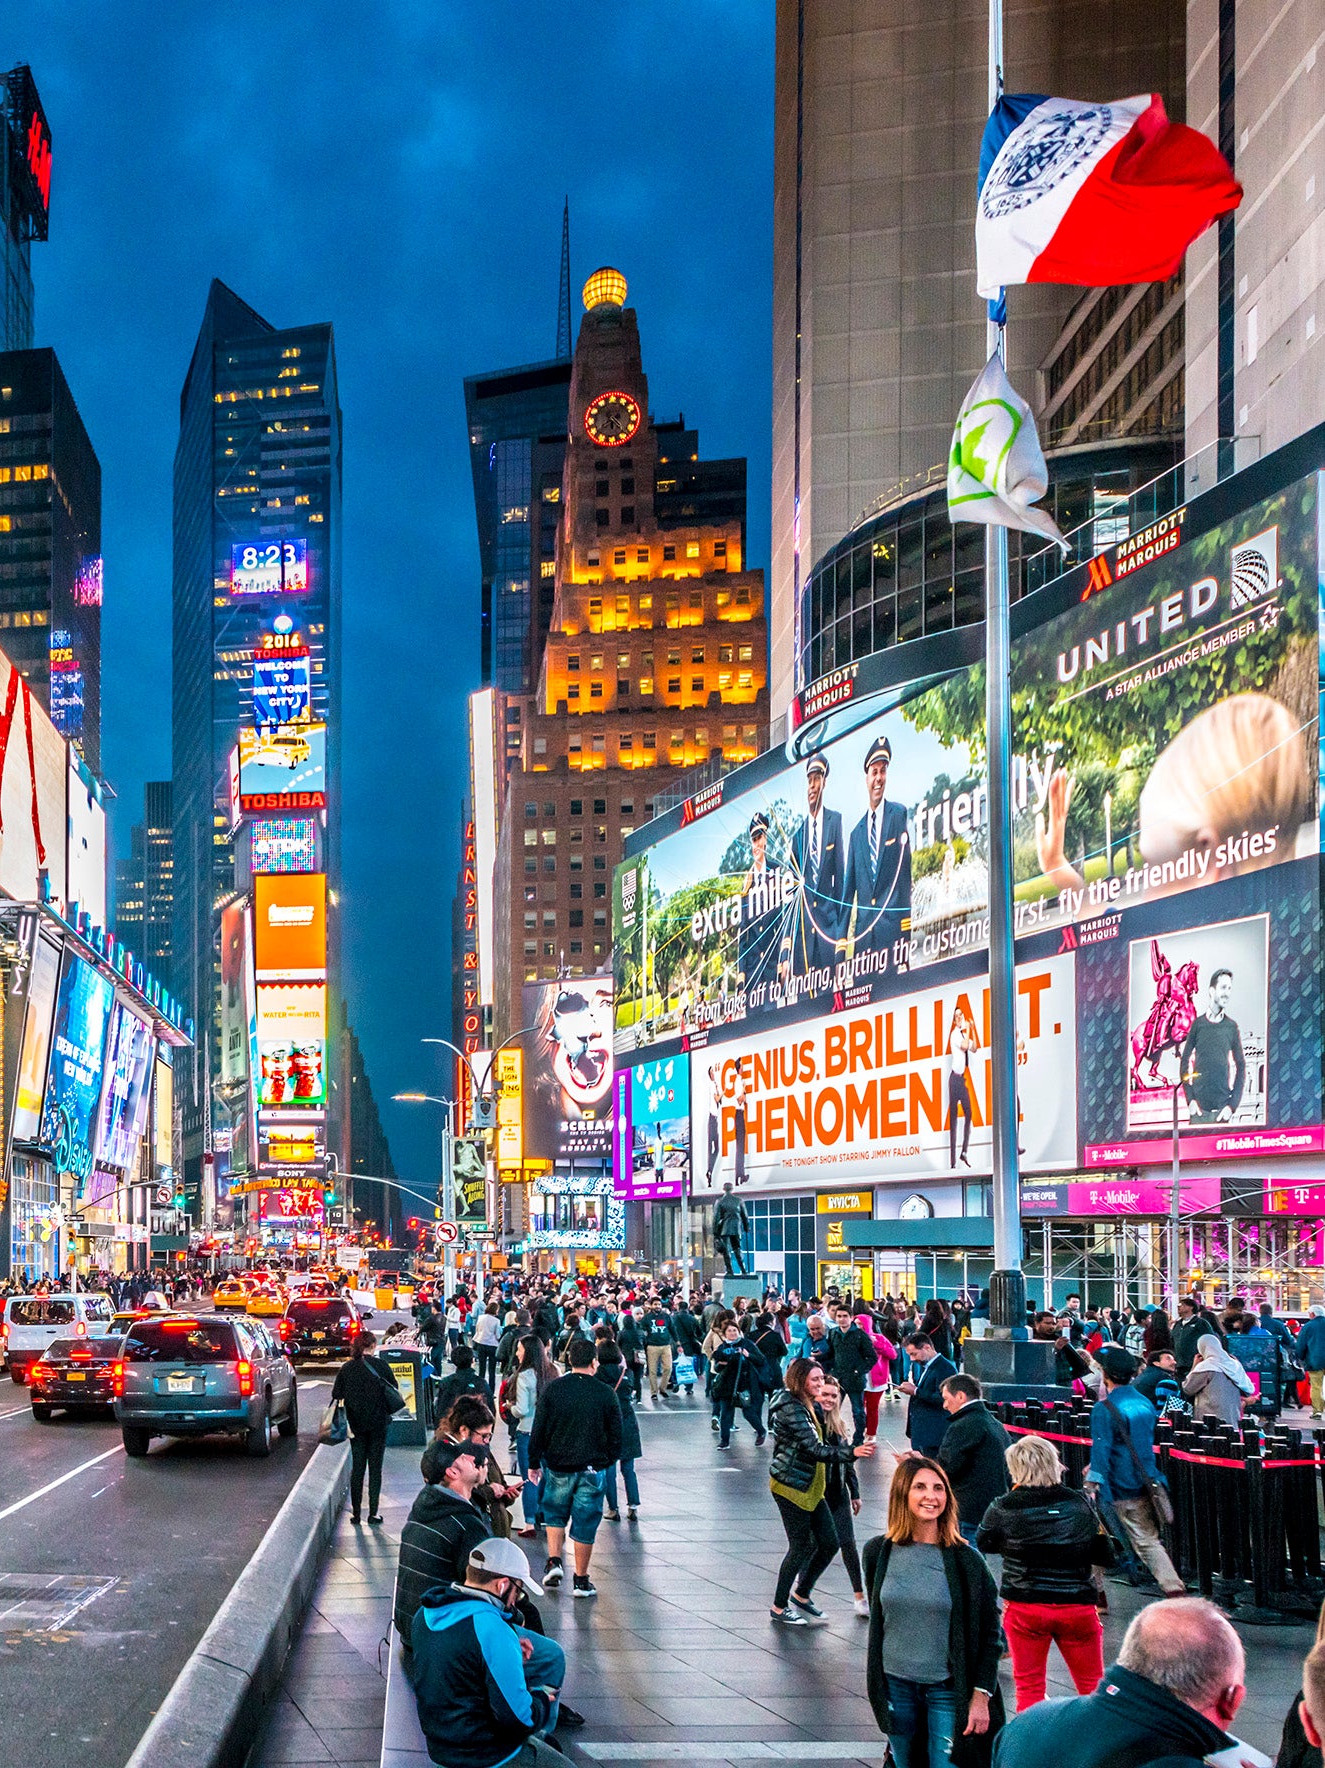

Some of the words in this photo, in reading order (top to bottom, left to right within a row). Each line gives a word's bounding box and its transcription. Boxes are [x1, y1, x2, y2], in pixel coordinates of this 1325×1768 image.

[996, 192, 1022, 208] 1625
[1117, 507, 1187, 559] MARRIOTT
[241, 543, 297, 570] 8:23
[1117, 531, 1179, 579] MARQUIS
[1056, 575, 1220, 684] UNITED
[263, 633, 301, 649] 2016
[255, 647, 309, 659] TOSHIBA
[1106, 689, 1114, 702] A
[1115, 674, 1143, 699] STAR
[1143, 646, 1199, 689] ALLIANCE
[1199, 620, 1255, 660] MEMBER
[274, 673, 290, 683] TO
[804, 662, 859, 702] MARRIOTT
[804, 683, 851, 717] MARQUIS
[241, 792, 324, 809] TOSHIBA
[695, 781, 724, 804] MARRIOTT
[695, 793, 722, 815] MARQUIS
[1214, 827, 1277, 868] skies
[690, 892, 743, 945] extra
[746, 866, 795, 920] mile
[1080, 913, 1123, 933] MARRIOTT
[694, 996, 721, 1025] From
[723, 985, 748, 1018] take
[748, 979, 767, 1008] off
[769, 979, 782, 1002] to
[783, 966, 835, 1004] landing,
[836, 948, 888, 989] putting
[892, 938, 918, 967] the
[922, 909, 990, 957] custome
[1012, 897, 1050, 930] irst.
[1057, 882, 1086, 920] fly
[1088, 869, 1121, 907] the
[1124, 846, 1211, 897] friendly
[1080, 926, 1119, 945] MARQUIS
[464, 951, 478, 969] &
[116, 941, 183, 1029] BROADWAY
[845, 984, 872, 999] MARRIOTT
[845, 992, 870, 1006] MARQUIS
[263, 1011, 287, 1019] WATER
[824, 972, 1062, 1078] BRILLIAT.
[560, 1119, 614, 1133] SCREAM
[1216, 1134, 1313, 1151] #TMobileTimesSquare
[782, 1158, 793, 1168] THE
[793, 1154, 818, 1168] TONIGHT
[819, 1153, 837, 1165] SHOW
[838, 1150, 869, 1164] STARRING
[870, 1149, 891, 1160] JIMMY
[892, 1145, 920, 1159] FALLON
[276, 1169, 307, 1177] SONY
[827, 1195, 861, 1210] INVICTA
[650, 1326, 667, 1334] NY
